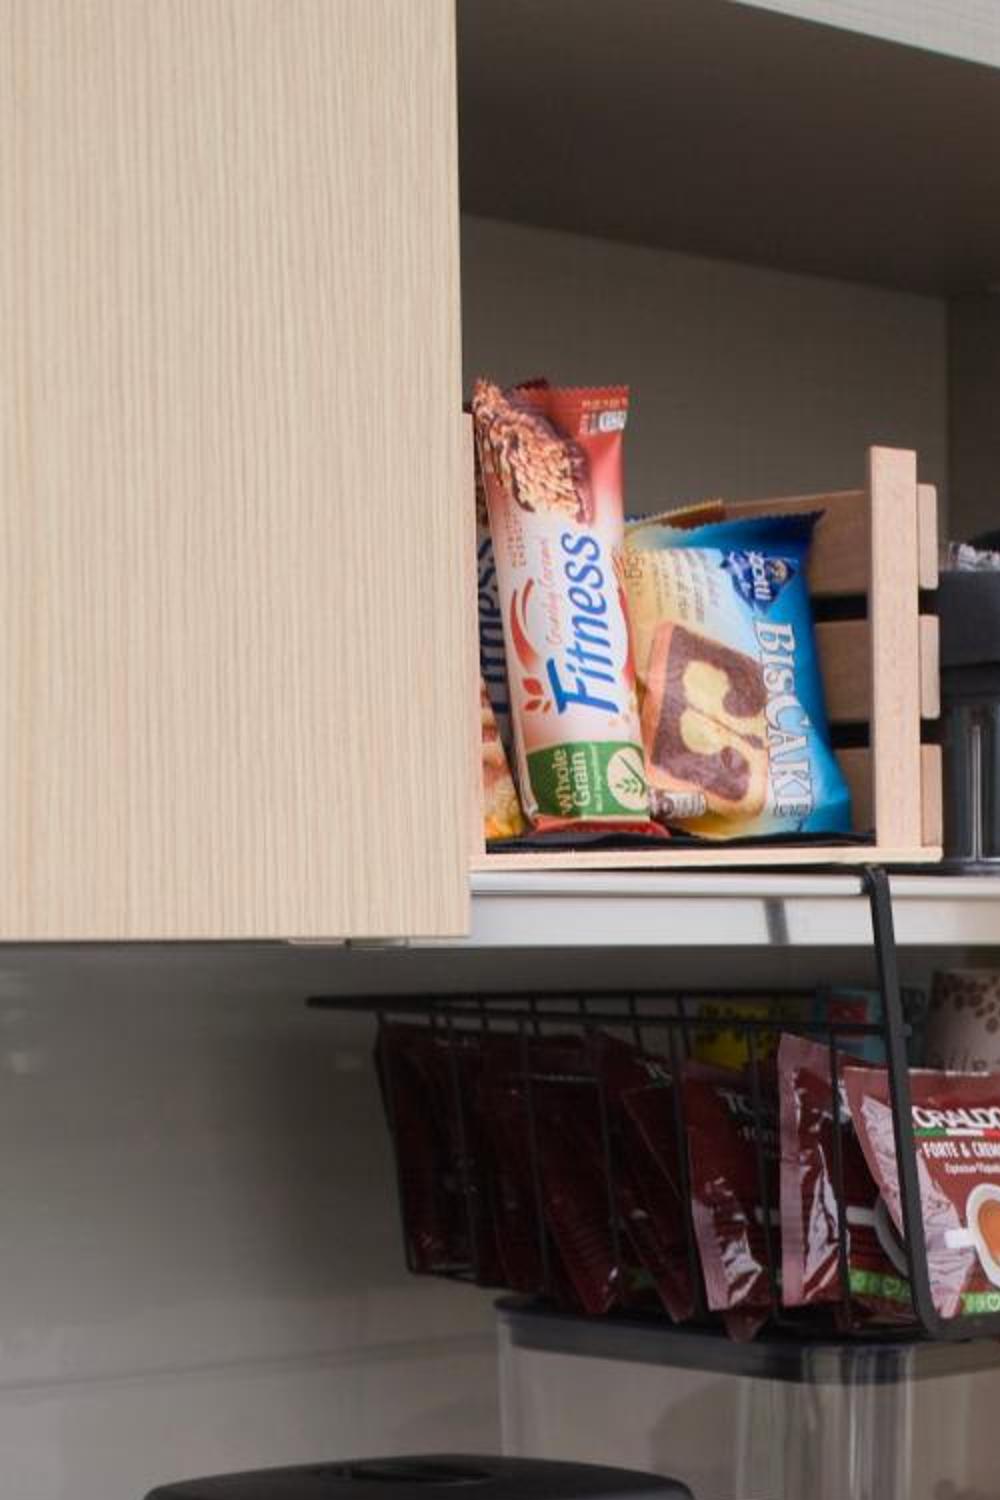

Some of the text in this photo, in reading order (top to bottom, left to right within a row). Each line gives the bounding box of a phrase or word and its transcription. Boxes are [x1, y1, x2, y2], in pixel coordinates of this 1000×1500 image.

[546, 532, 620, 715] Fitness
[552, 748, 573, 816] Whole
[570, 751, 591, 807] Grain
